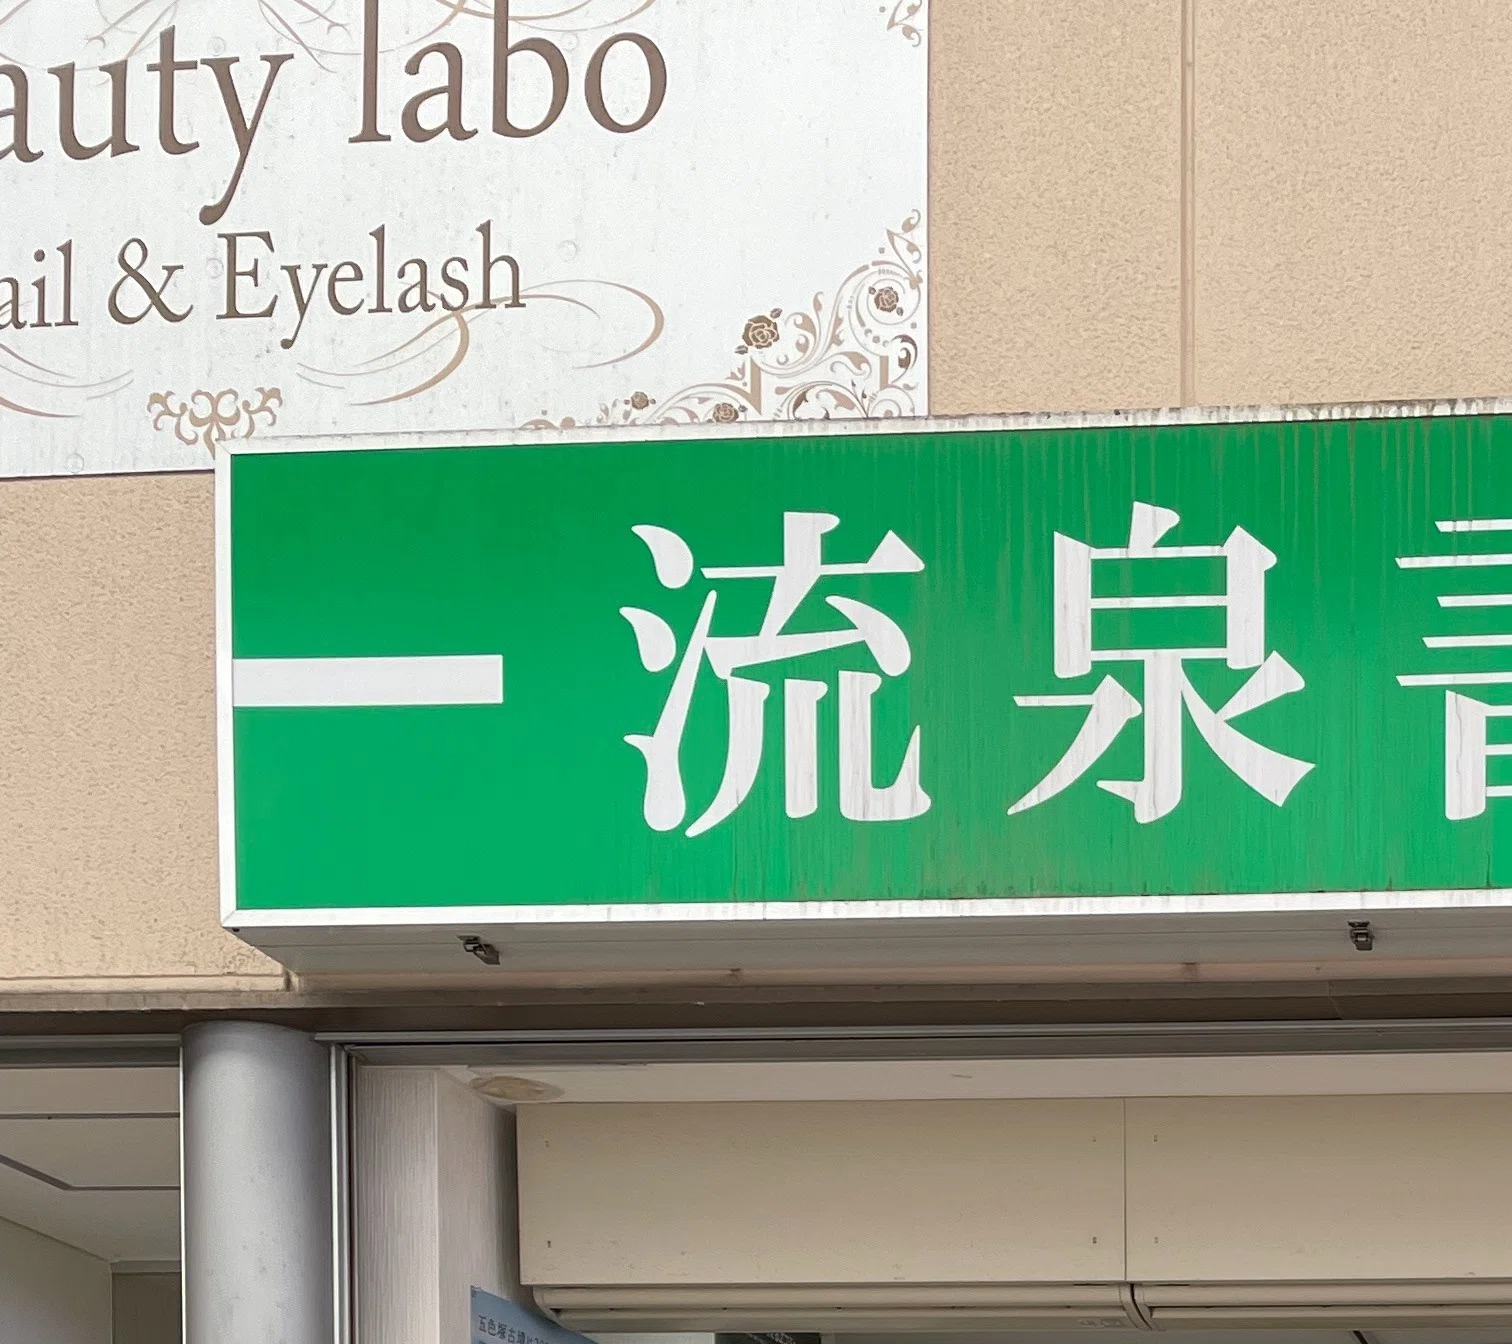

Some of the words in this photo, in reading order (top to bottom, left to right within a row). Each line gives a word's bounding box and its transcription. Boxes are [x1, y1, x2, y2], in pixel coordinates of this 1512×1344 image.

[349, 0, 668, 143] labo
[108, 238, 193, 323] &
[216, 220, 526, 350] Eyelash
